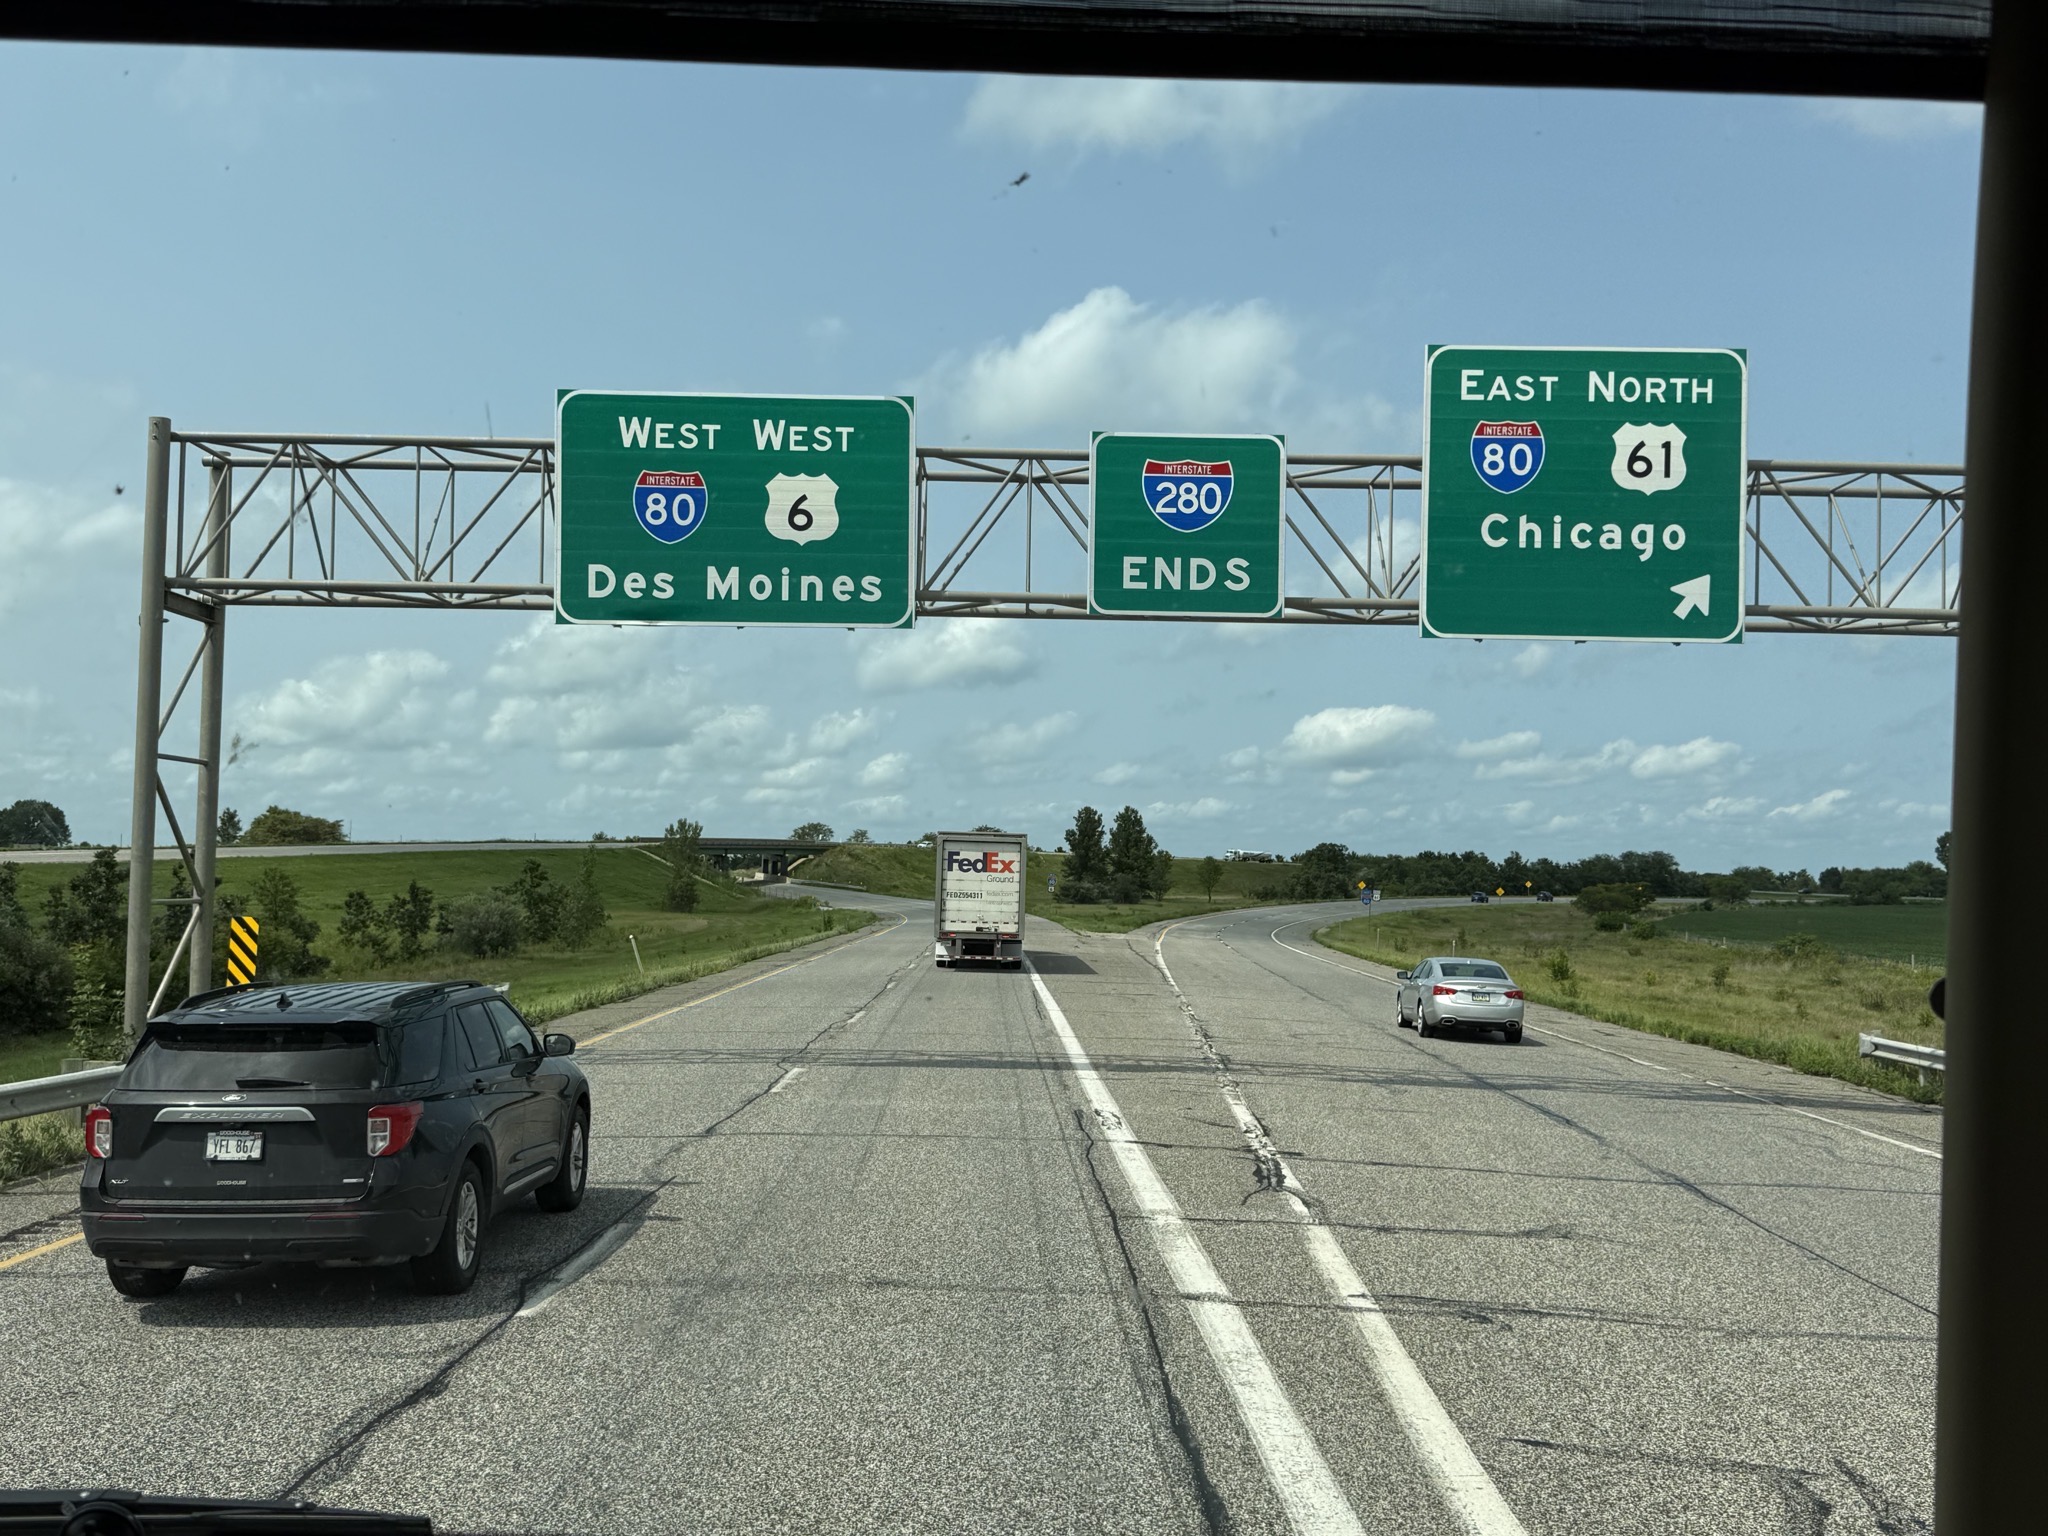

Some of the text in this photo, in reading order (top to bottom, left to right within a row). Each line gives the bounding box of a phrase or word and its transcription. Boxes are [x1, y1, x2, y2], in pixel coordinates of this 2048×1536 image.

[1460, 369, 1714, 404] EAST NORTH
[618, 416, 855, 453] WEST WEST
[1483, 426, 1533, 436] INTERSTATE
[1164, 464, 1213, 475] INTERSTATE
[1482, 443, 1533, 477] 80
[1627, 440, 1672, 479] 61
[645, 475, 697, 487] INTERSTATE
[1155, 481, 1222, 515] 280
[644, 492, 697, 526] 80
[787, 493, 814, 532] 6
[1480, 513, 1687, 562] Chicago
[587, 563, 883, 602] Des Moines
[1122, 555, 1251, 591] ENDS
[947, 851, 1016, 874] FedEx
[986, 874, 1015, 884] Ground
[177, 1111, 286, 1120] EXPLORER
[213, 1138, 257, 1154] YFL 867
